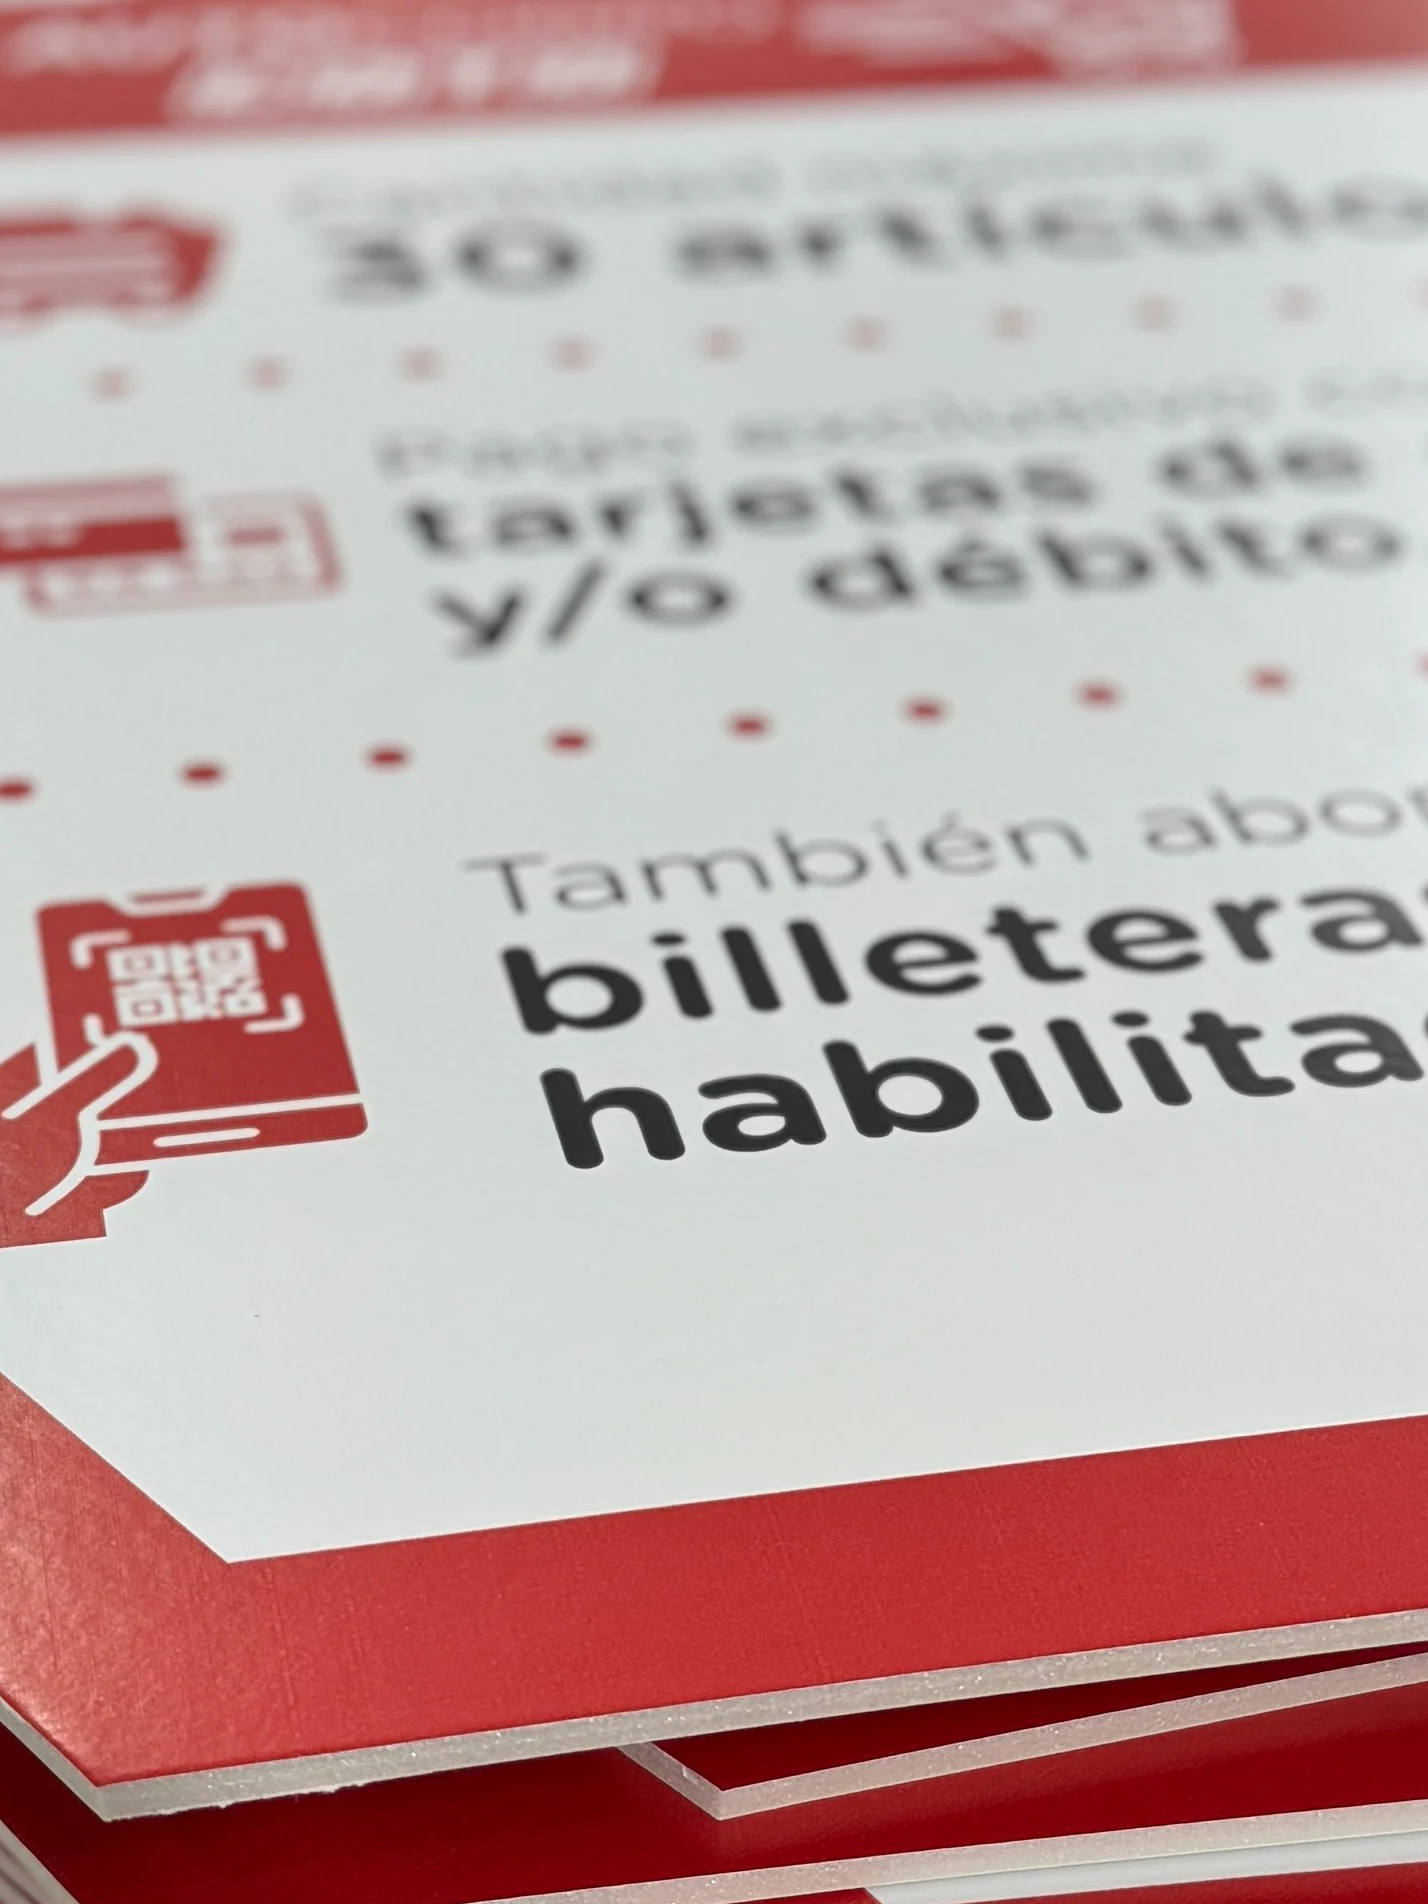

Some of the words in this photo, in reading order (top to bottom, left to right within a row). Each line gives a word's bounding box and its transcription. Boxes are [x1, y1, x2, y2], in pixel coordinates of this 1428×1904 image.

[402, 434, 1096, 560] tarjetas
[1156, 410, 1372, 494] de
[432, 560, 738, 656] y/o
[464, 806, 1090, 918] También
